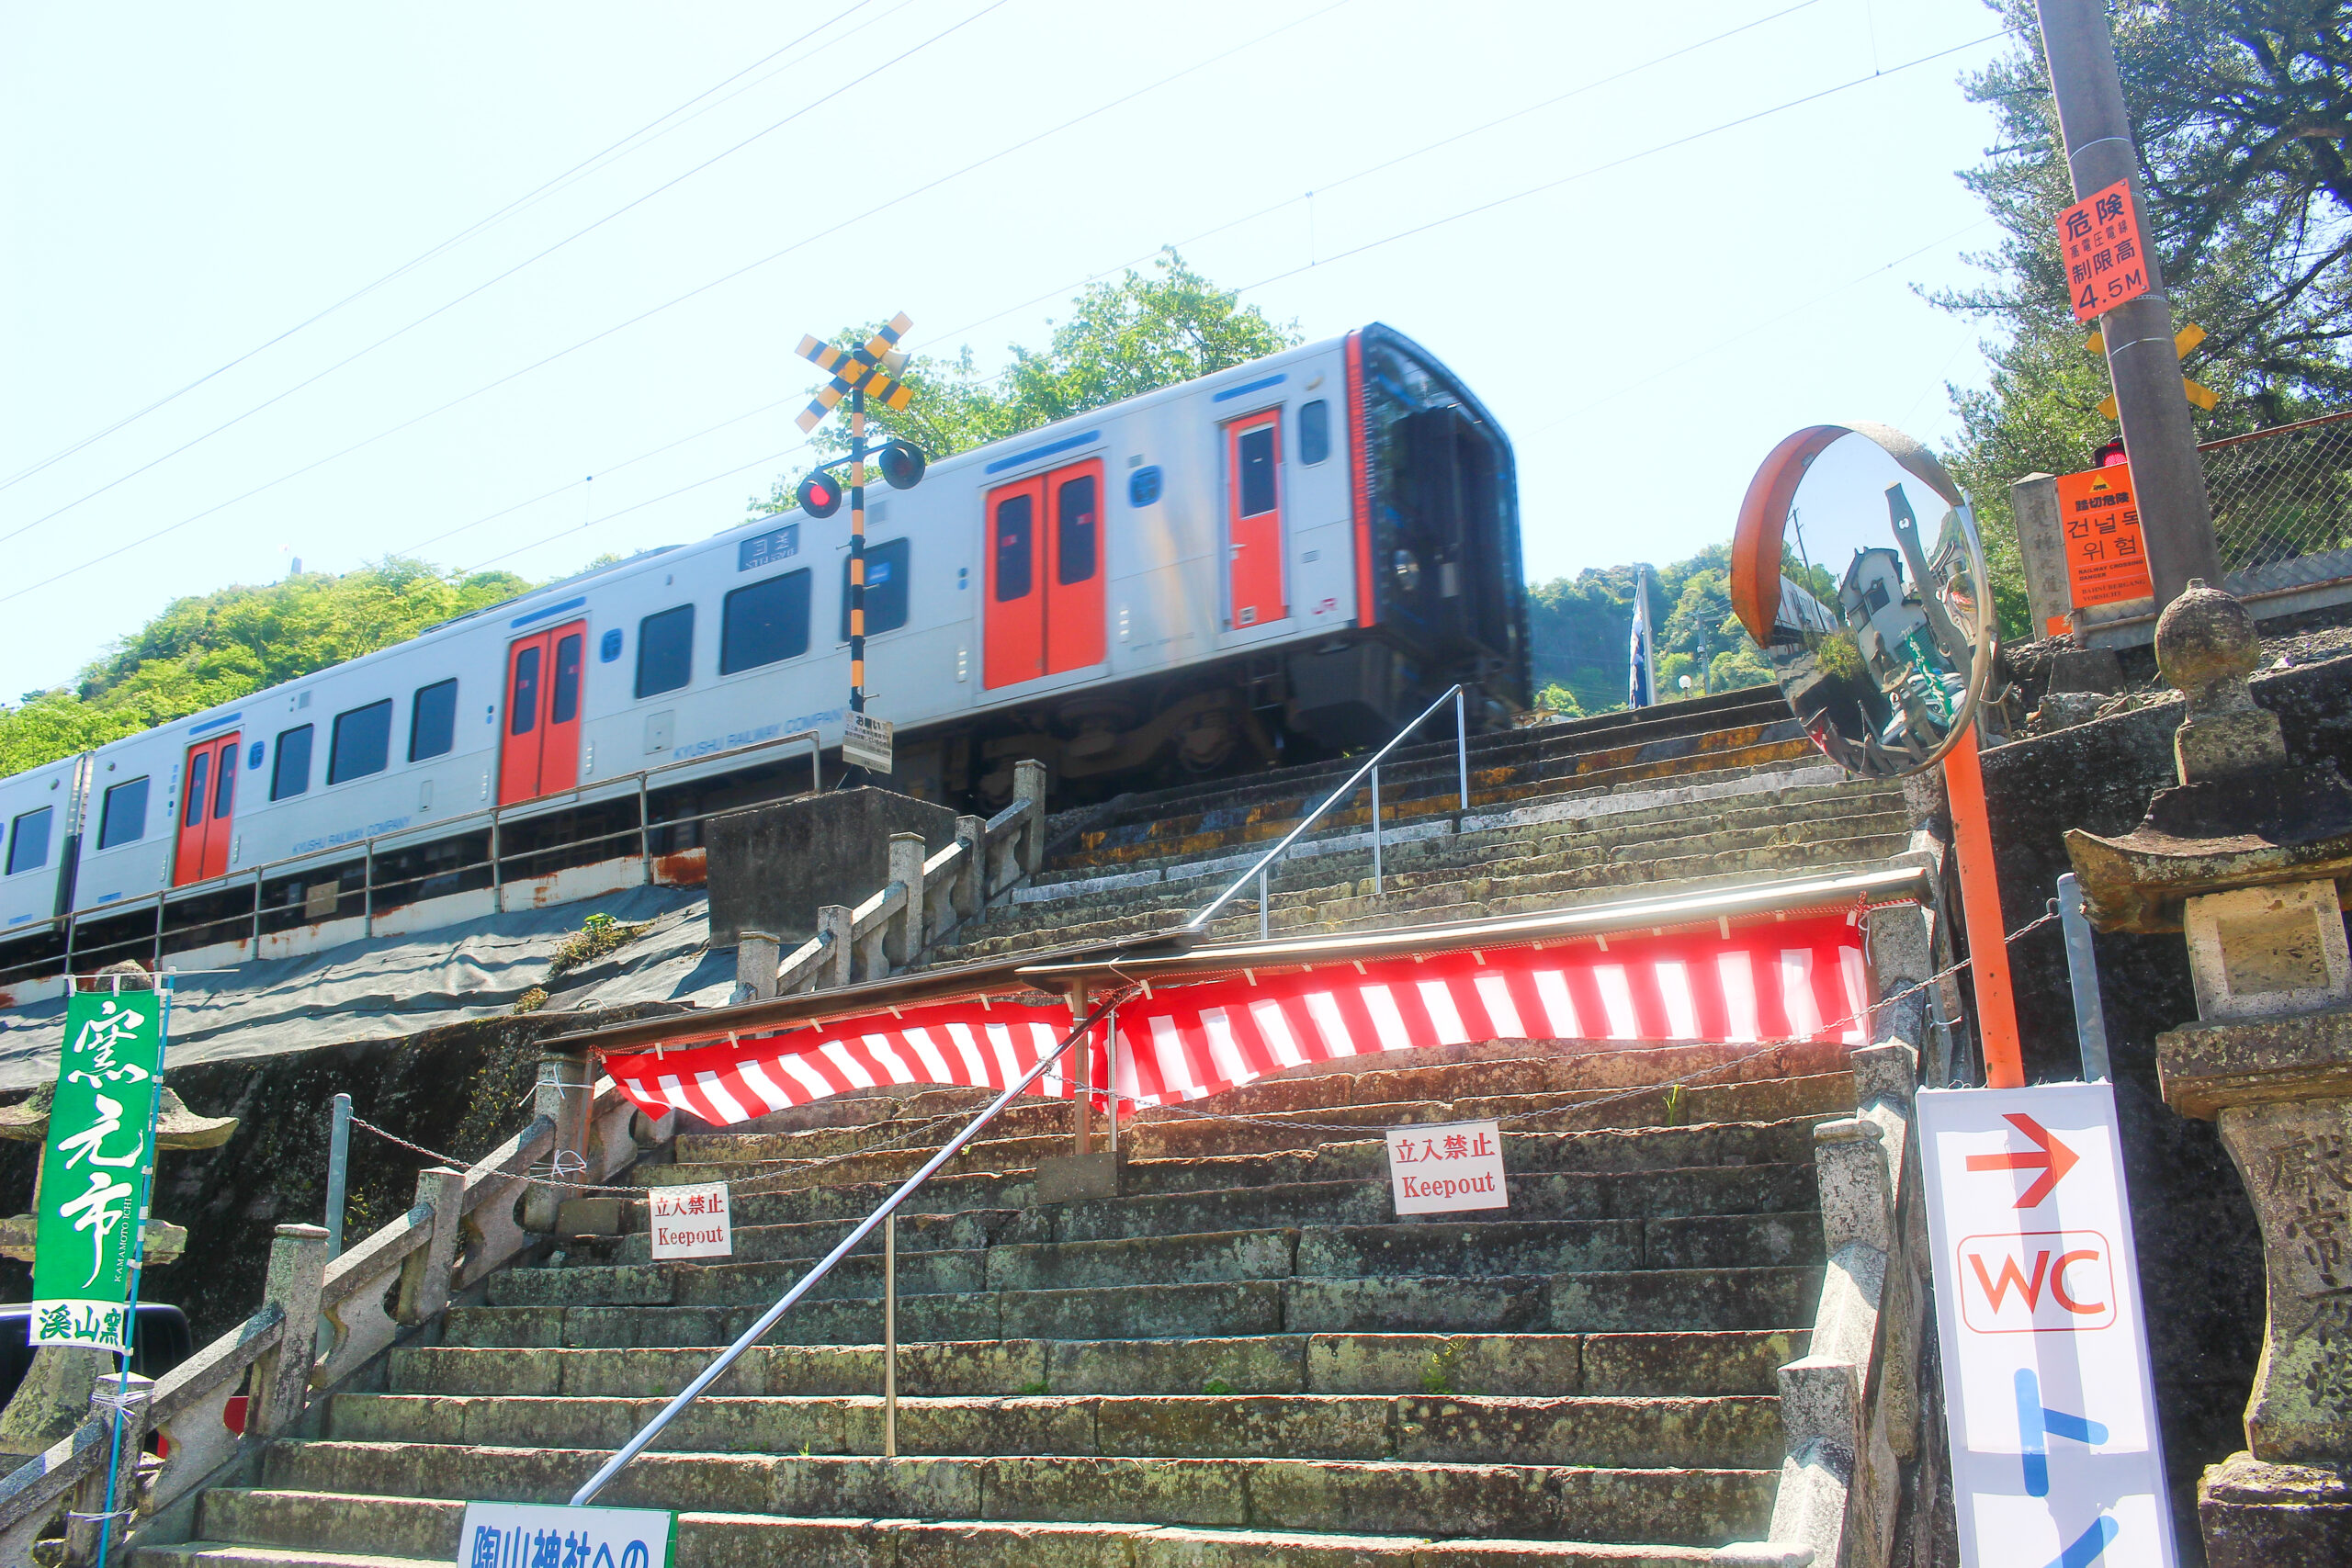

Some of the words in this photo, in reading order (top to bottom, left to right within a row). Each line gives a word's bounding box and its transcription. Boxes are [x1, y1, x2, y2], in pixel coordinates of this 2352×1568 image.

[2065, 193, 2125, 242] 危険
[2069, 220, 2129, 259] 高電圧電線
[2072, 238, 2135, 284] 制限高
[2078, 269, 2142, 309] 4.5M
[2075, 491, 2130, 512] 踏切危険
[2082, 535, 2137, 560] 위험
[2078, 566, 2108, 574] RAILWAY
[2109, 559, 2143, 570] CROSSING
[2079, 572, 2106, 581] DANGER
[673, 736, 724, 761] KYUSHU
[58, 1000, 149, 1289] 窯元市
[1395, 1132, 1496, 1164] 立入禁止
[1401, 1171, 1496, 1199] Keepout
[655, 1193, 725, 1217] 立入禁止
[114, 1222, 130, 1282] KAMAMOTO
[122, 1198, 132, 1220] ICHI
[658, 1225, 724, 1247] Keepout
[1967, 1249, 2106, 1314] WC
